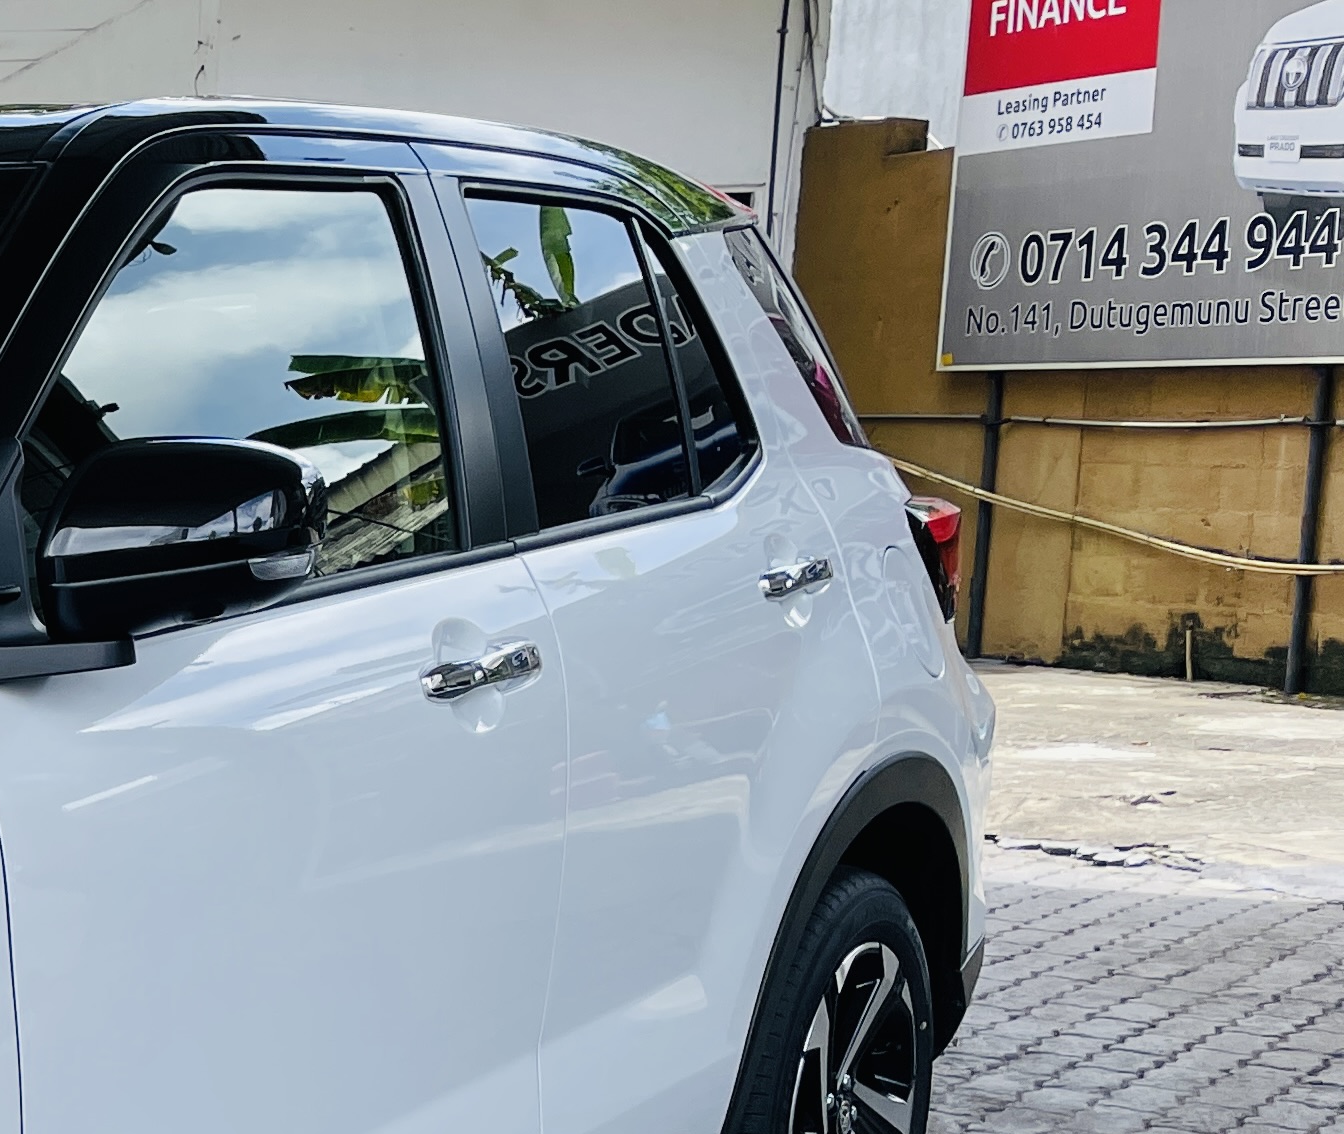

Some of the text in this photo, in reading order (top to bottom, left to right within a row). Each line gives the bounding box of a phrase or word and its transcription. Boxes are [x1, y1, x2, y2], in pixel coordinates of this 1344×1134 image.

[997, 88, 1106, 116] Leasing Partner
[1012, 112, 1102, 139] 0763 958 454
[1018, 207, 1343, 287] 0714 344 944
[1069, 299, 1250, 335] Dutugemunu
[1259, 289, 1343, 325] Stree
